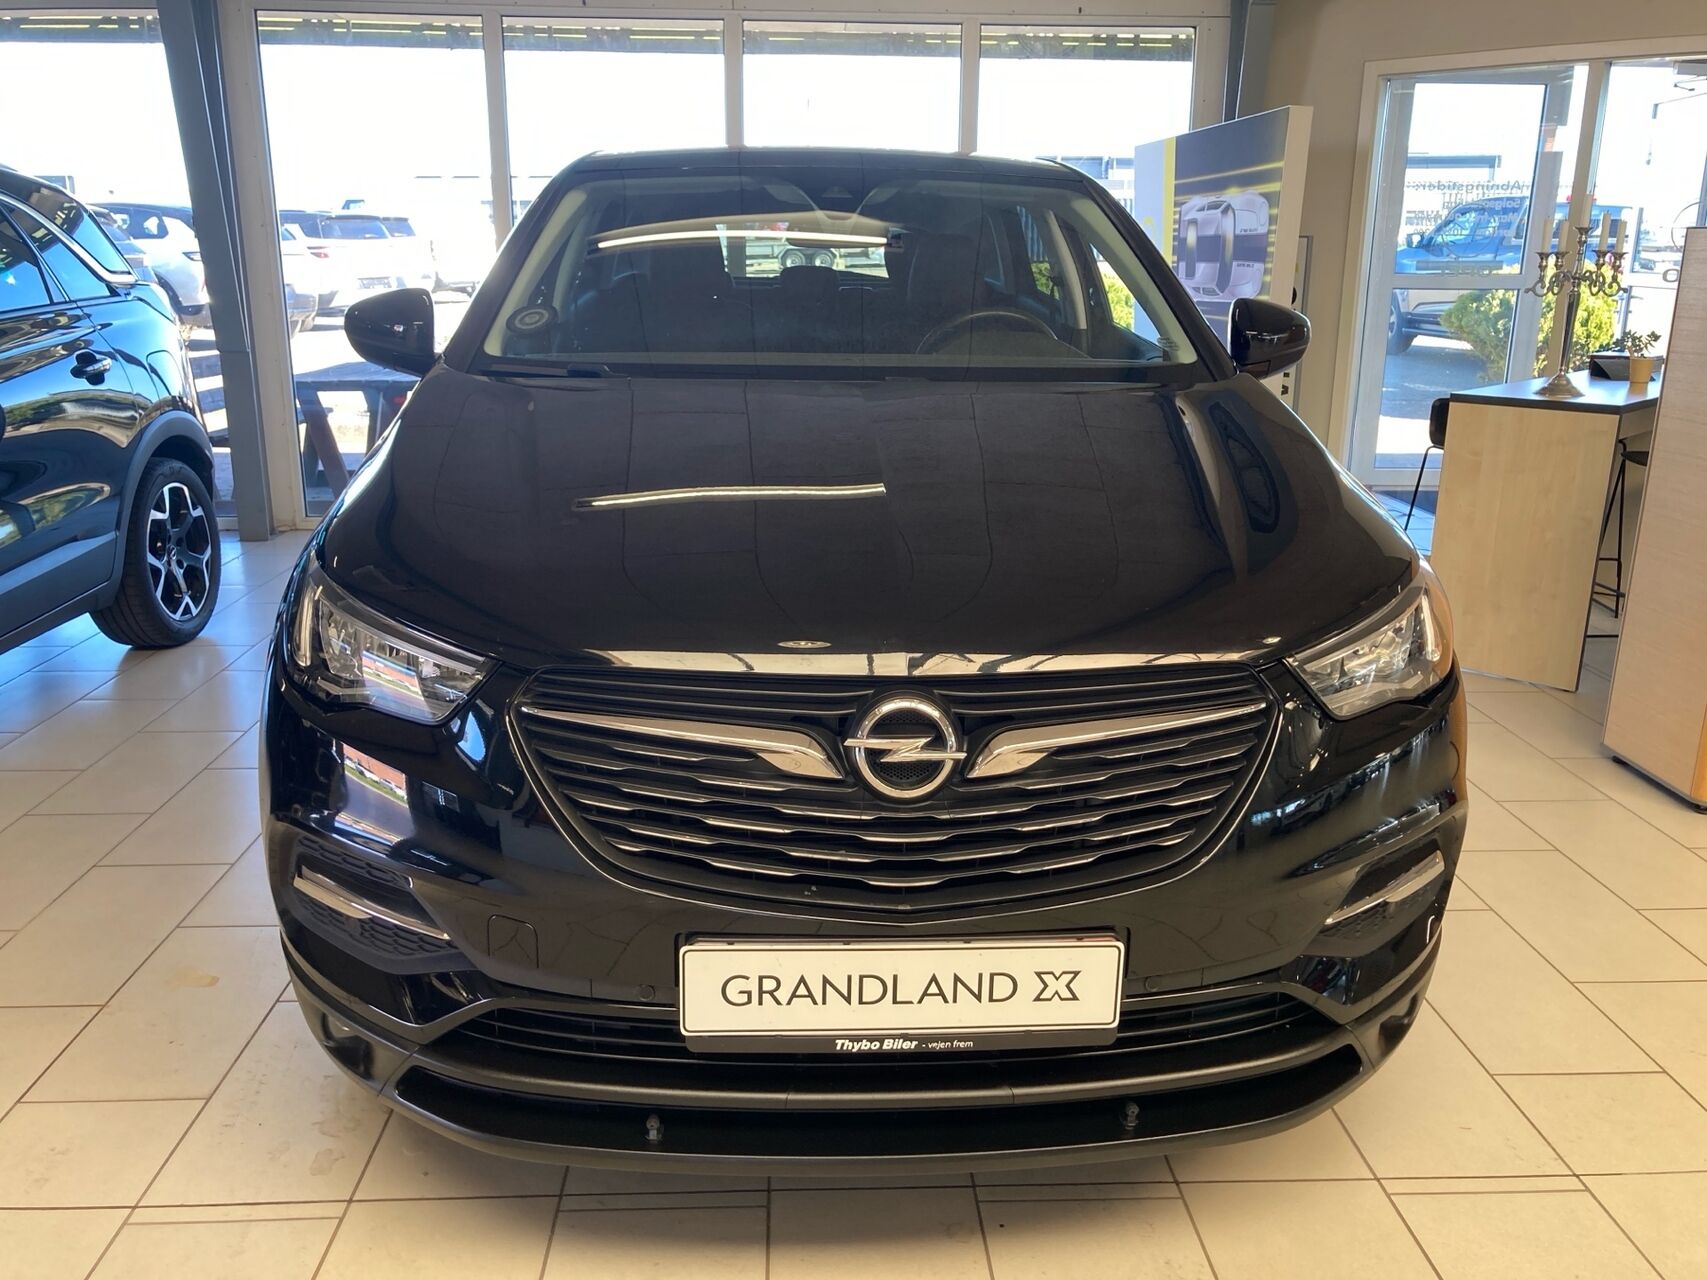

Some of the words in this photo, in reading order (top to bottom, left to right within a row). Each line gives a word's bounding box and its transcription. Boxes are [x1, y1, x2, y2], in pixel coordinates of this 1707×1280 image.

[720, 972, 1018, 1007] GRANDLAND
[1032, 970, 1082, 1002] X
[835, 1039, 880, 1052] Thybo
[882, 1038, 918, 1050] Biler
[928, 1041, 951, 1050] vejen
[953, 1040, 974, 1048] frem
